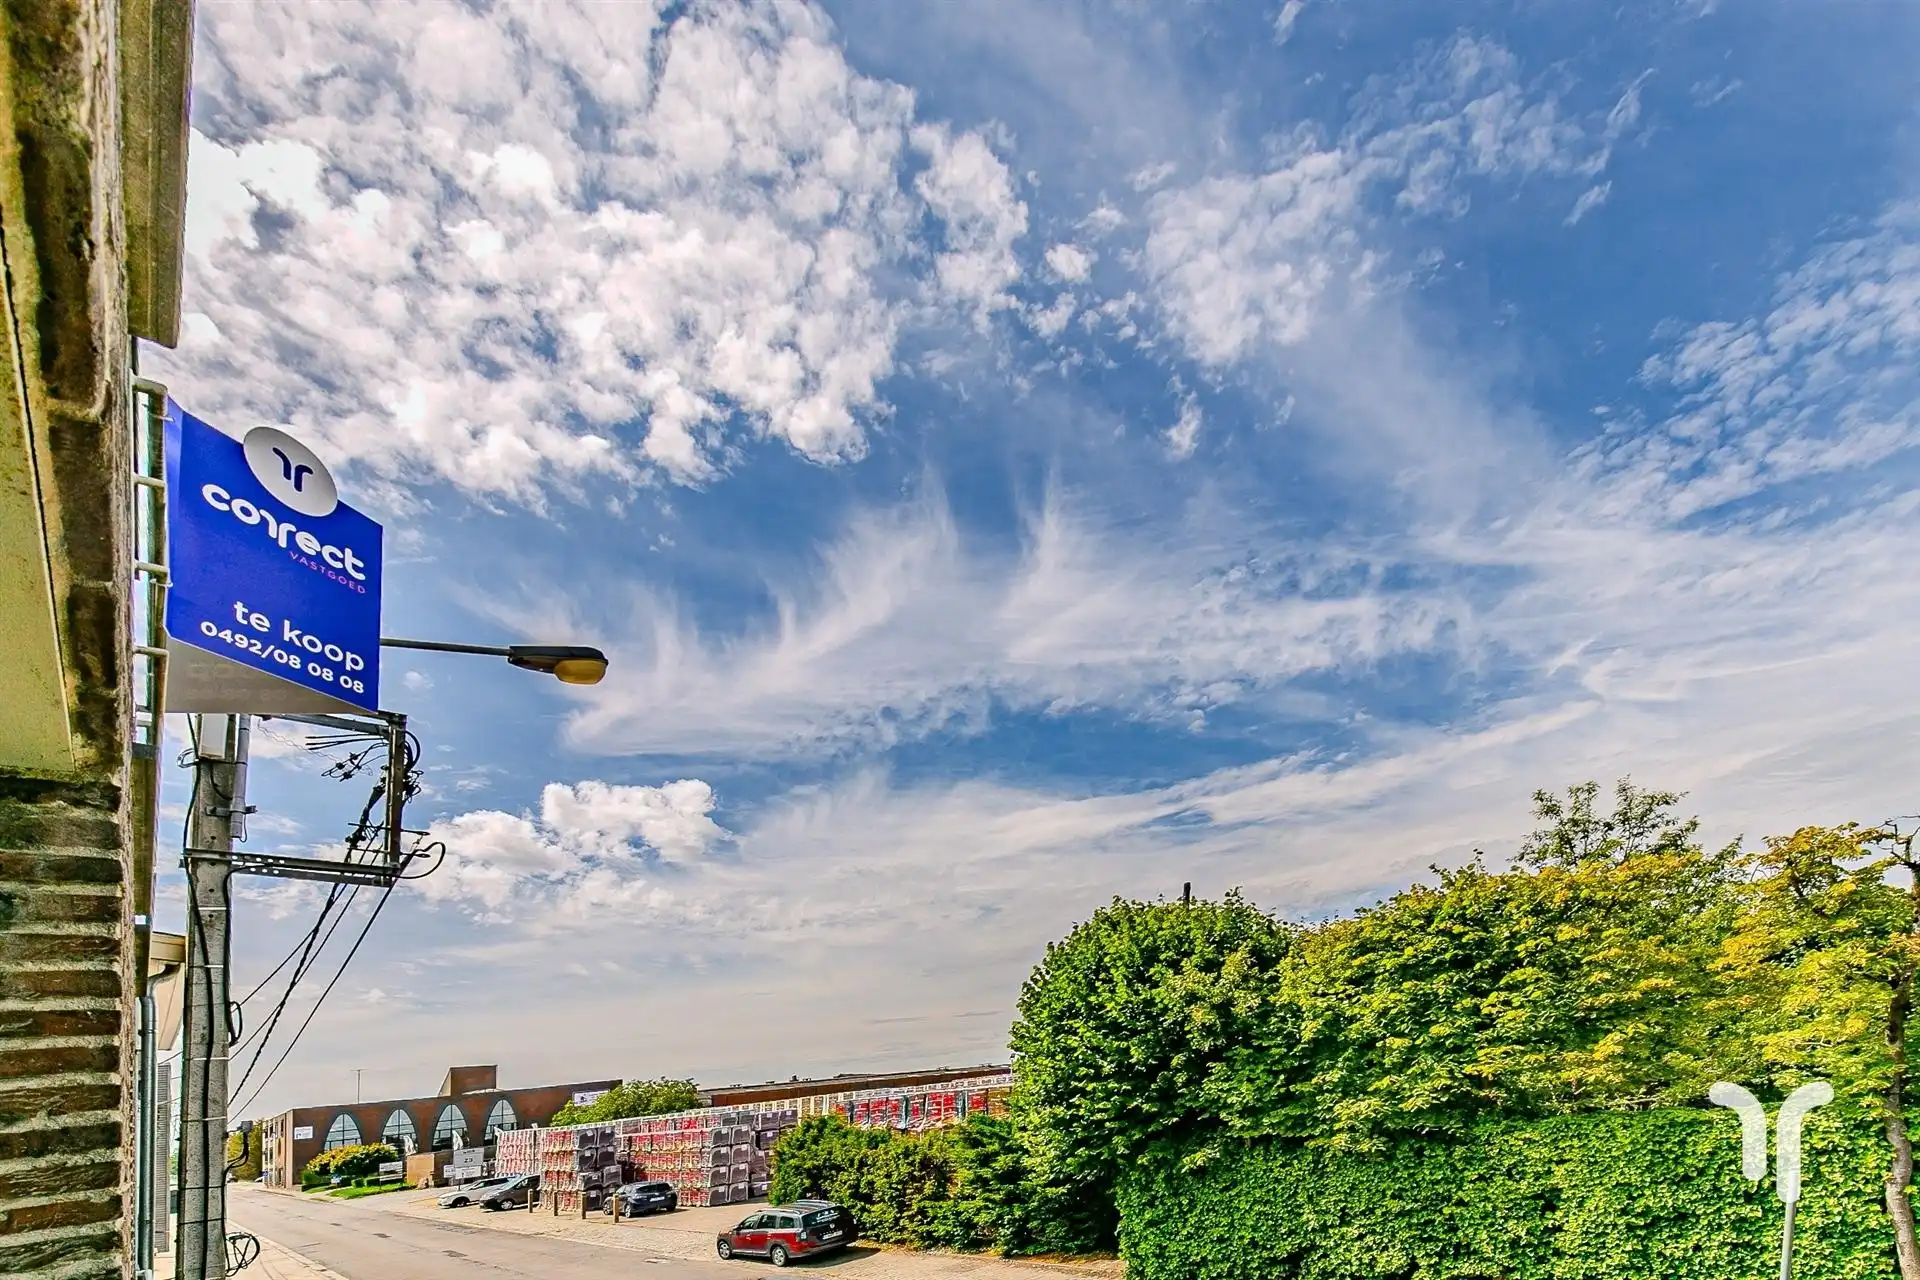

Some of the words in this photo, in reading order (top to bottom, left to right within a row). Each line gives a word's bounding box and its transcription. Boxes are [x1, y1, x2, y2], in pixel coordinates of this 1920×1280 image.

[202, 484, 366, 581] correct
[289, 550, 366, 594] VASTGOED
[200, 621, 301, 670] 0492/08
[307, 662, 334, 682] 08
[339, 675, 364, 694] 08
[233, 601, 271, 632] te
[283, 619, 364, 674] koop
